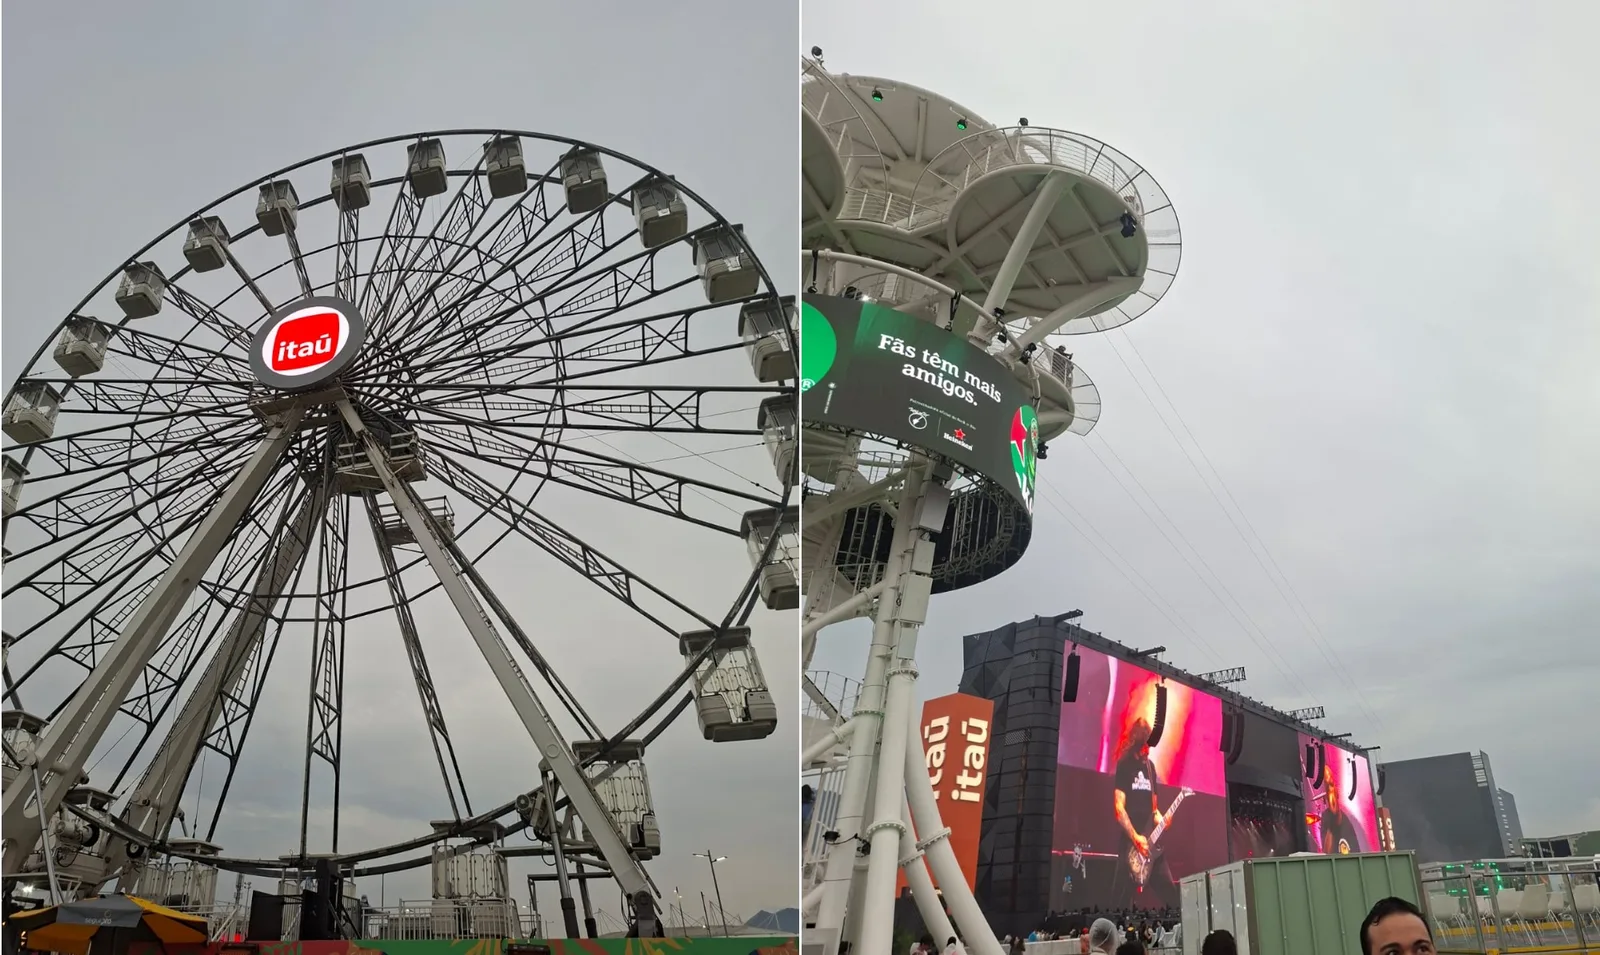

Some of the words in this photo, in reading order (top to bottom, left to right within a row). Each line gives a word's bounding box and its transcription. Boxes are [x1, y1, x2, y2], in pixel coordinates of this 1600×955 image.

[277, 333, 331, 361] itaú
[878, 333, 916, 359] Fãs
[922, 350, 959, 379] têm
[964, 370, 1001, 403] mais
[902, 362, 978, 407] amigos.
[951, 717, 988, 802] itaú
